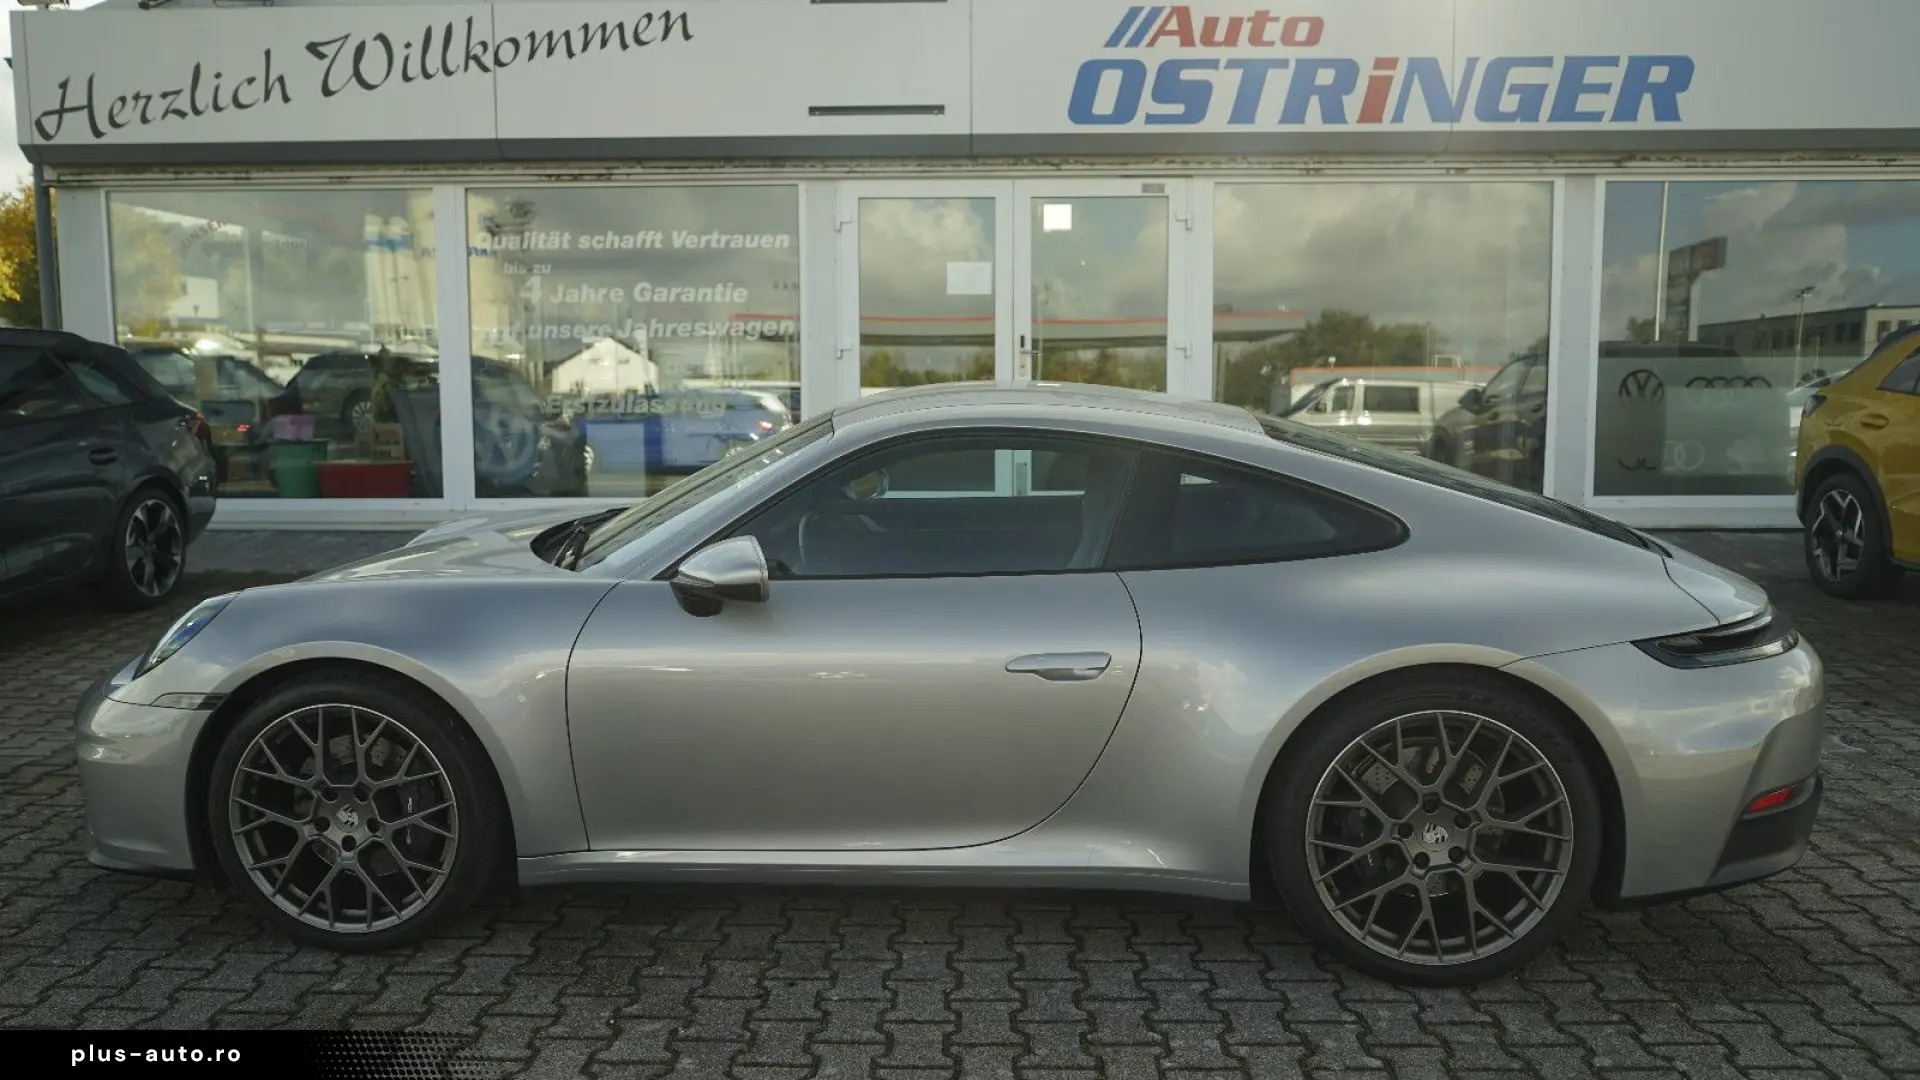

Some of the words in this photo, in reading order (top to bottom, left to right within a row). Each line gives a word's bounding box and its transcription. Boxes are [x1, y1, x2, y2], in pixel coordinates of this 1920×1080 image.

[34, 48, 292, 141] Herzlich
[304, 9, 693, 98] Willkommen
[474, 230, 571, 251] Qualität
[578, 230, 664, 250] schafft
[671, 230, 790, 250] Vertrauen
[504, 261, 527, 274] bis
[532, 263, 552, 274] zu
[550, 283, 624, 304] Jahre
[633, 282, 749, 303] Garantie
[528, 324, 613, 340] unsere
[616, 318, 796, 341] Jahreswagen
